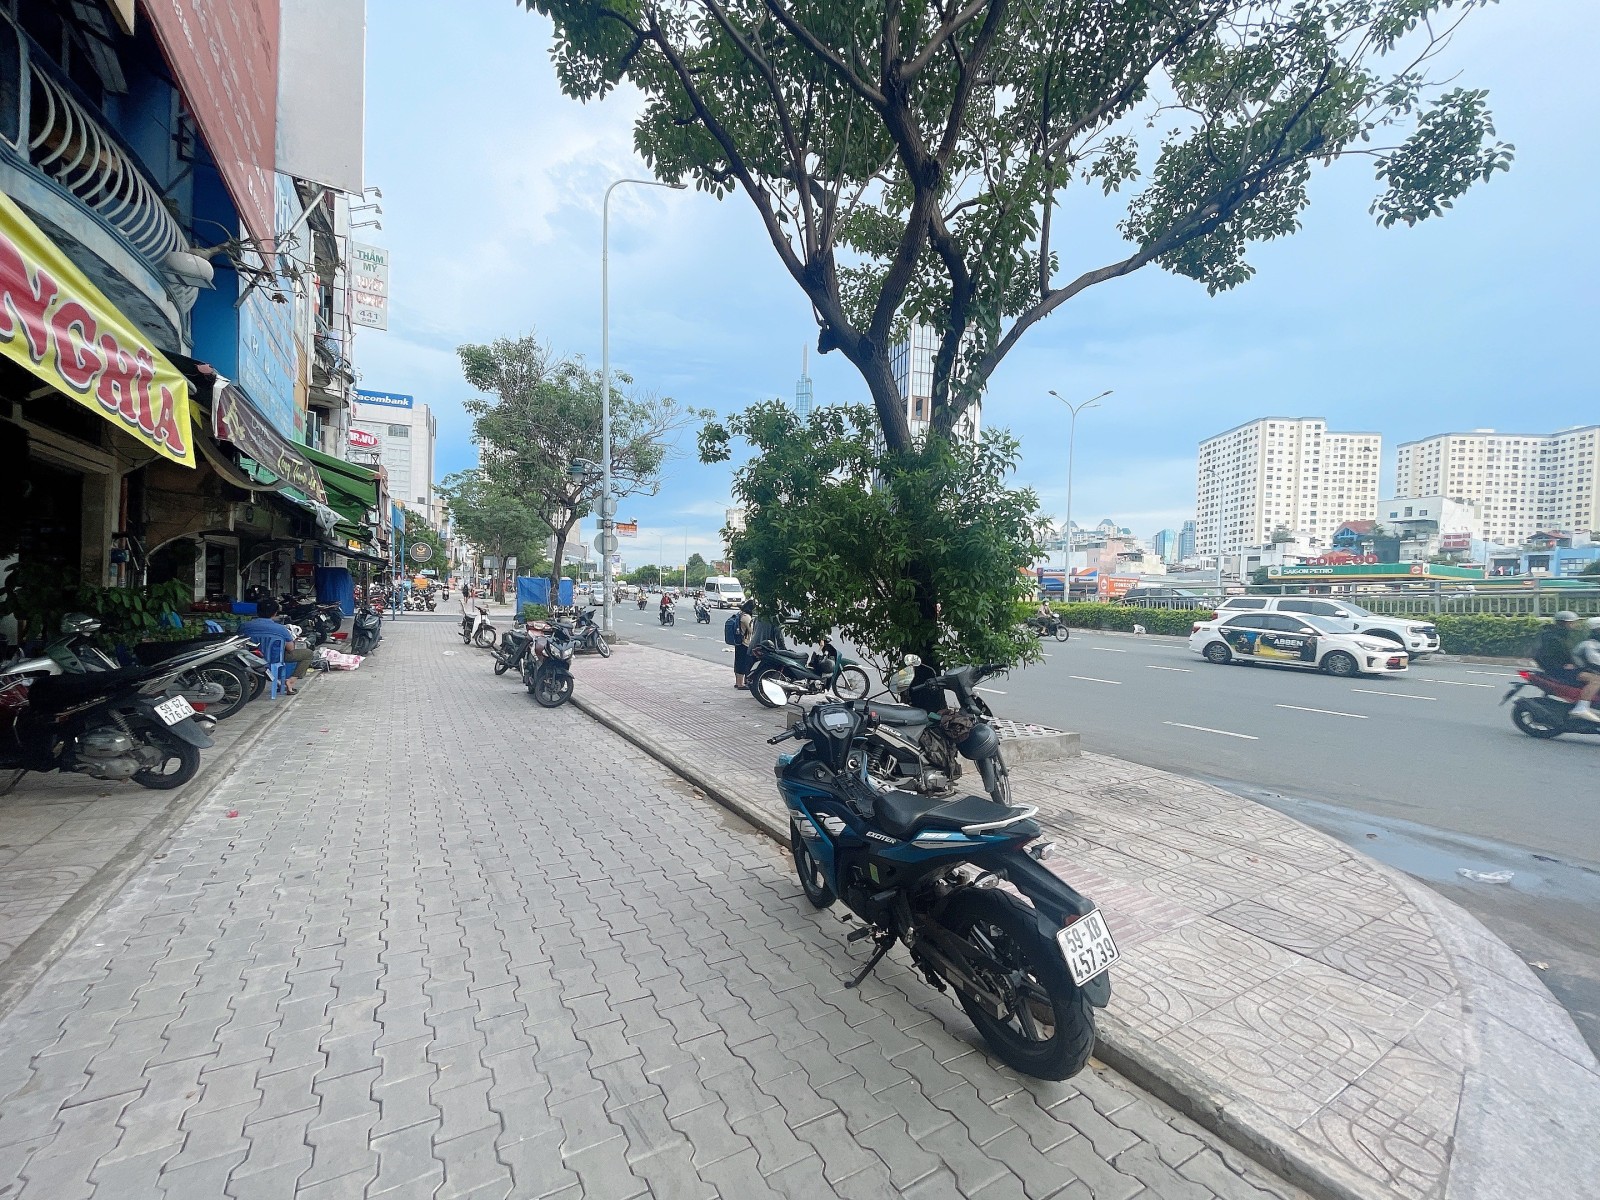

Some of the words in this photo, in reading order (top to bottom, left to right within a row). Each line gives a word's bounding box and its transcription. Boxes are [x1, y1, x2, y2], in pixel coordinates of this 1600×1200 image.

[359, 310, 379, 320] 441
[351, 390, 410, 407] Sacombank
[1306, 554, 1378, 567] COMECO
[1273, 638, 1304, 647] ABBEN
[865, 831, 897, 844] EXCITER
